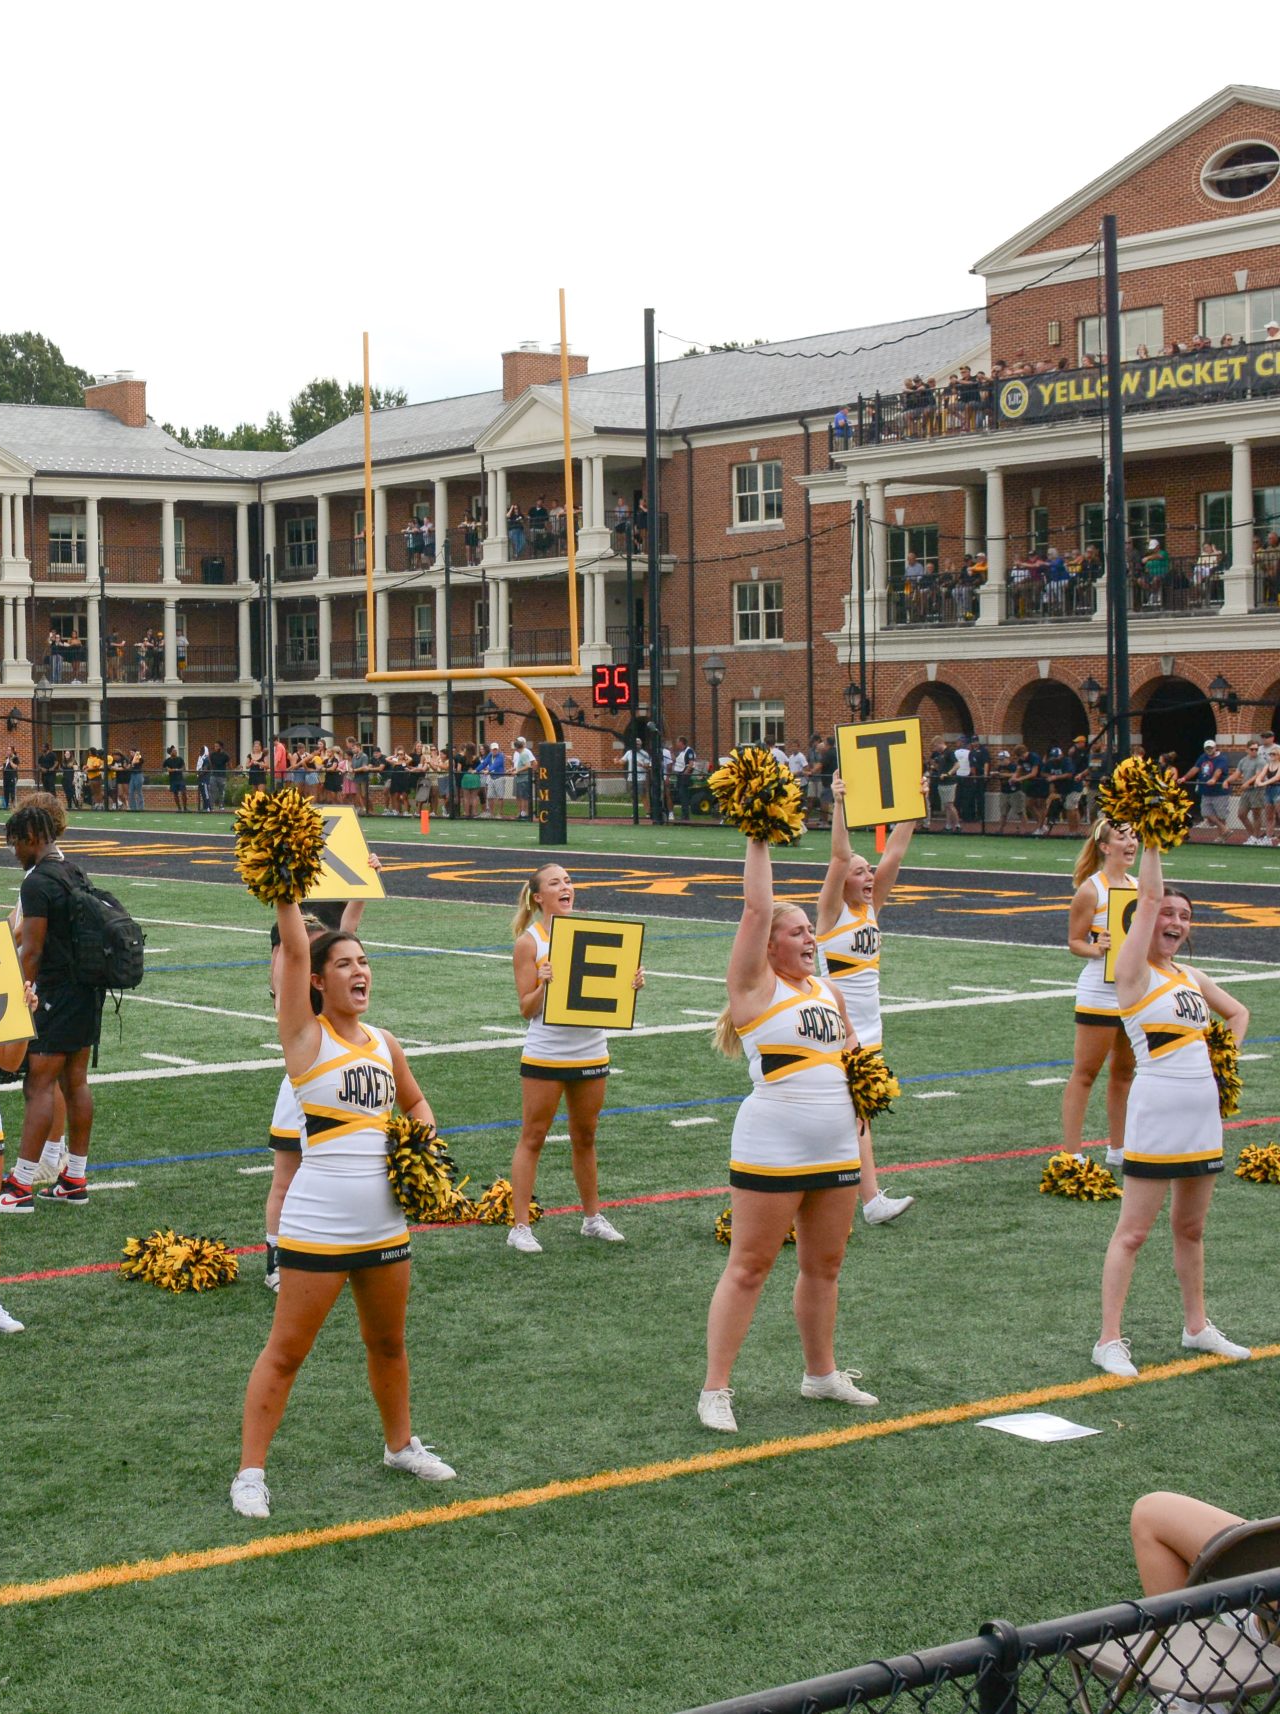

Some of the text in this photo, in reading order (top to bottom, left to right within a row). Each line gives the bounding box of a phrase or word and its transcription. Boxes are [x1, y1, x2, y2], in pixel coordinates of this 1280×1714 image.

[1147, 356, 1248, 397] JACKET
[594, 666, 630, 704] 25
[855, 729, 907, 810] T
[566, 929, 624, 1014] E
[338, 1064, 395, 1109] JACKETS
